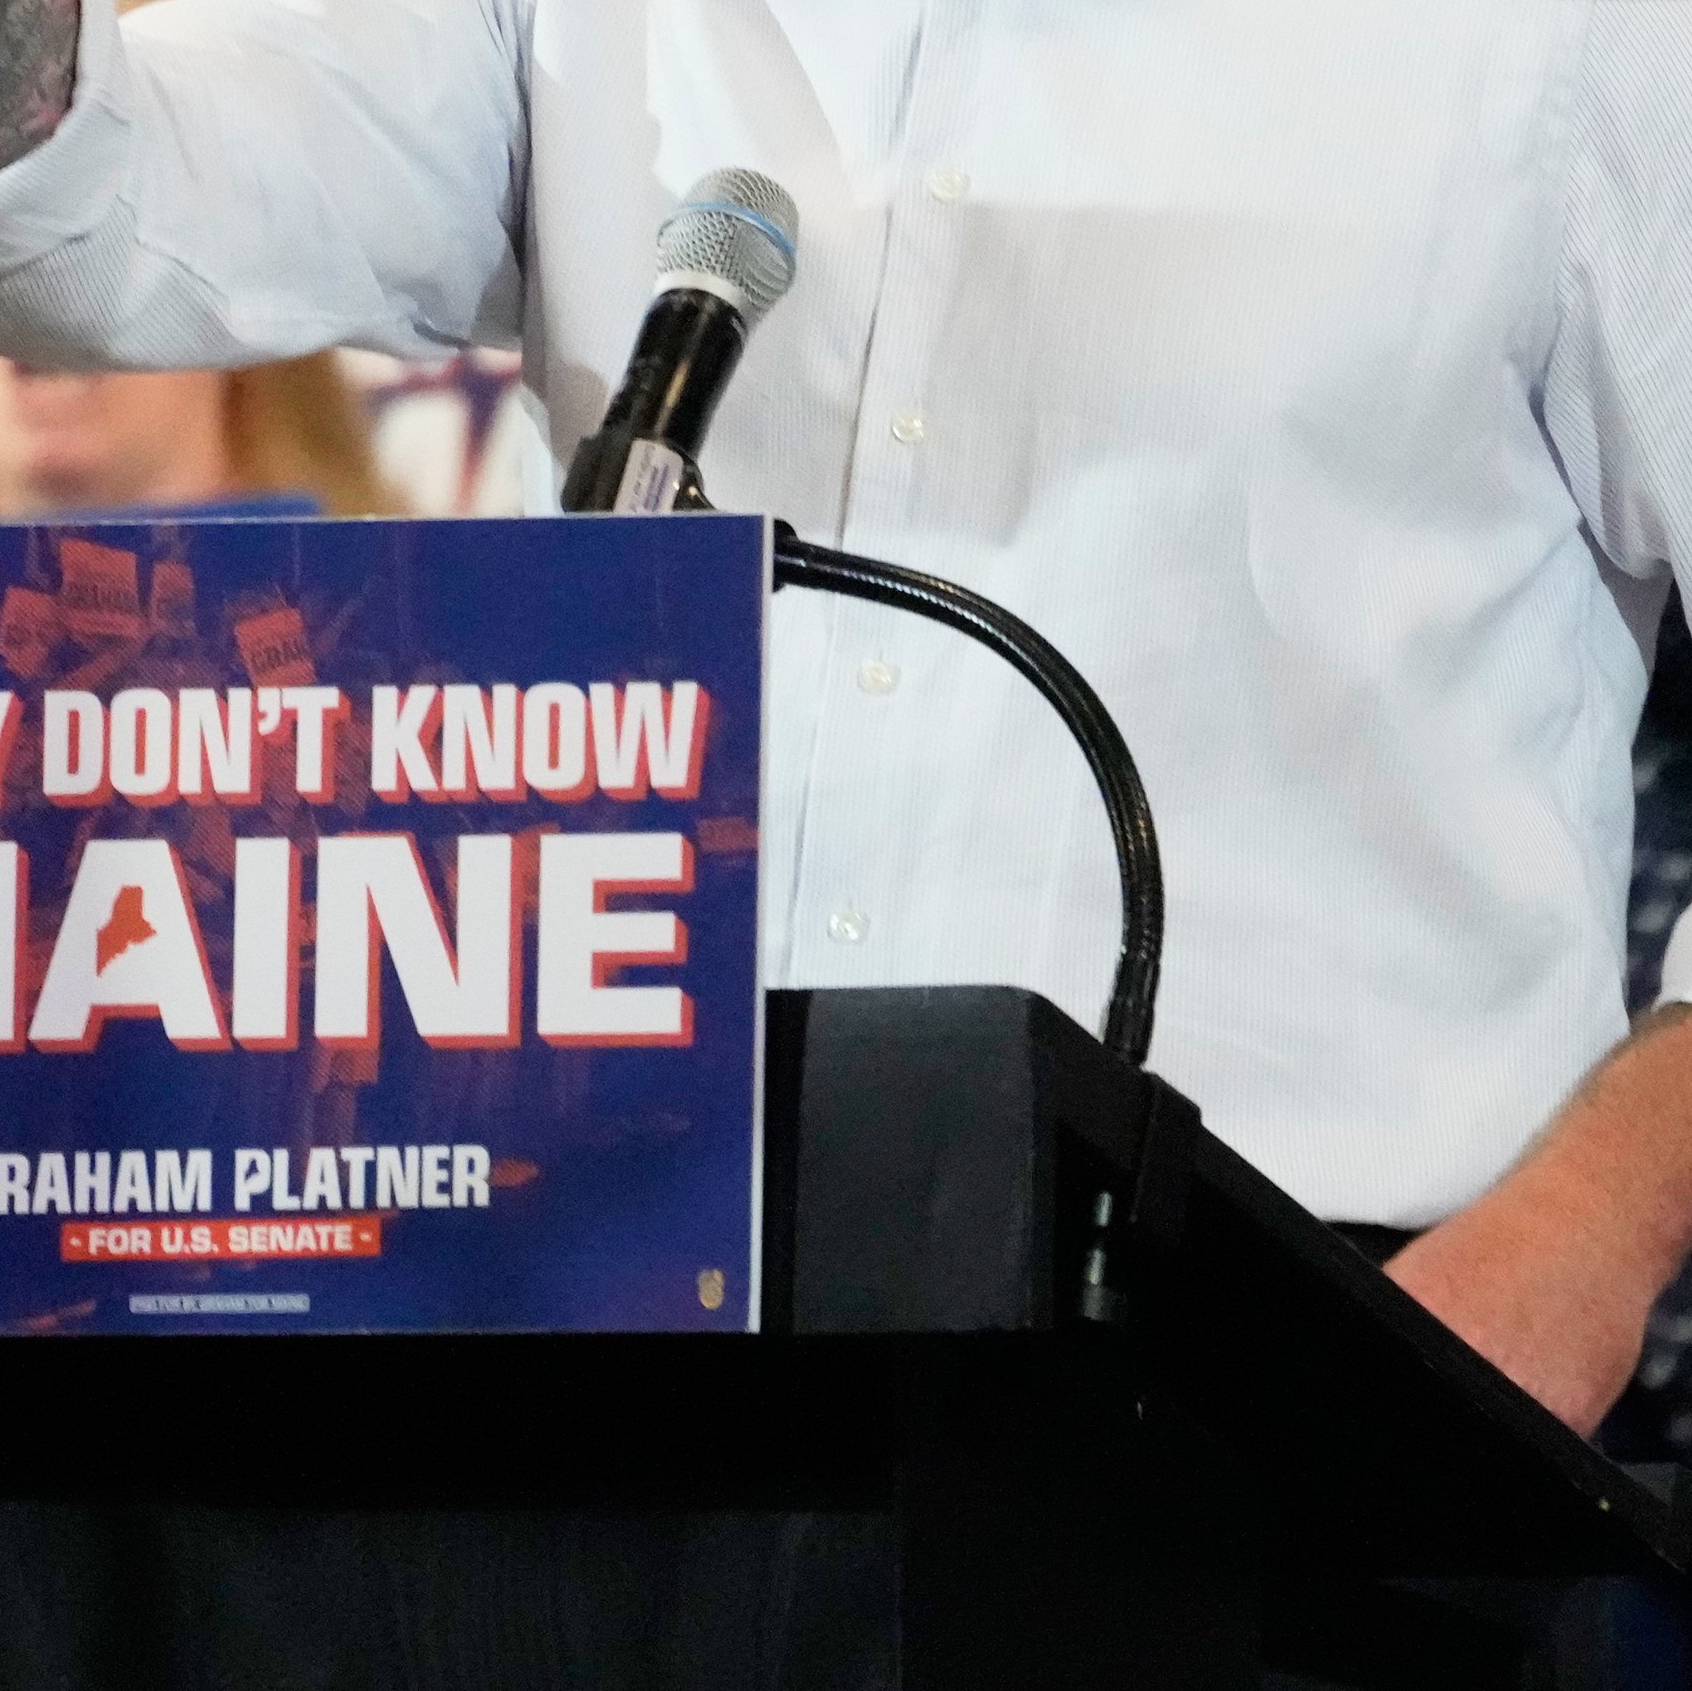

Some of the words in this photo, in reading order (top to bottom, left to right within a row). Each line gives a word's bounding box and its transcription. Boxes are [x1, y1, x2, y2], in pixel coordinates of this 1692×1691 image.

[44, 687, 339, 797] DON'T
[371, 682, 699, 795] KNOW
[232, 1144, 491, 1211] PLATNER
[88, 1227, 152, 1255] FOR
[161, 1226, 217, 1254] U.S.
[228, 1224, 352, 1253] SENATE
